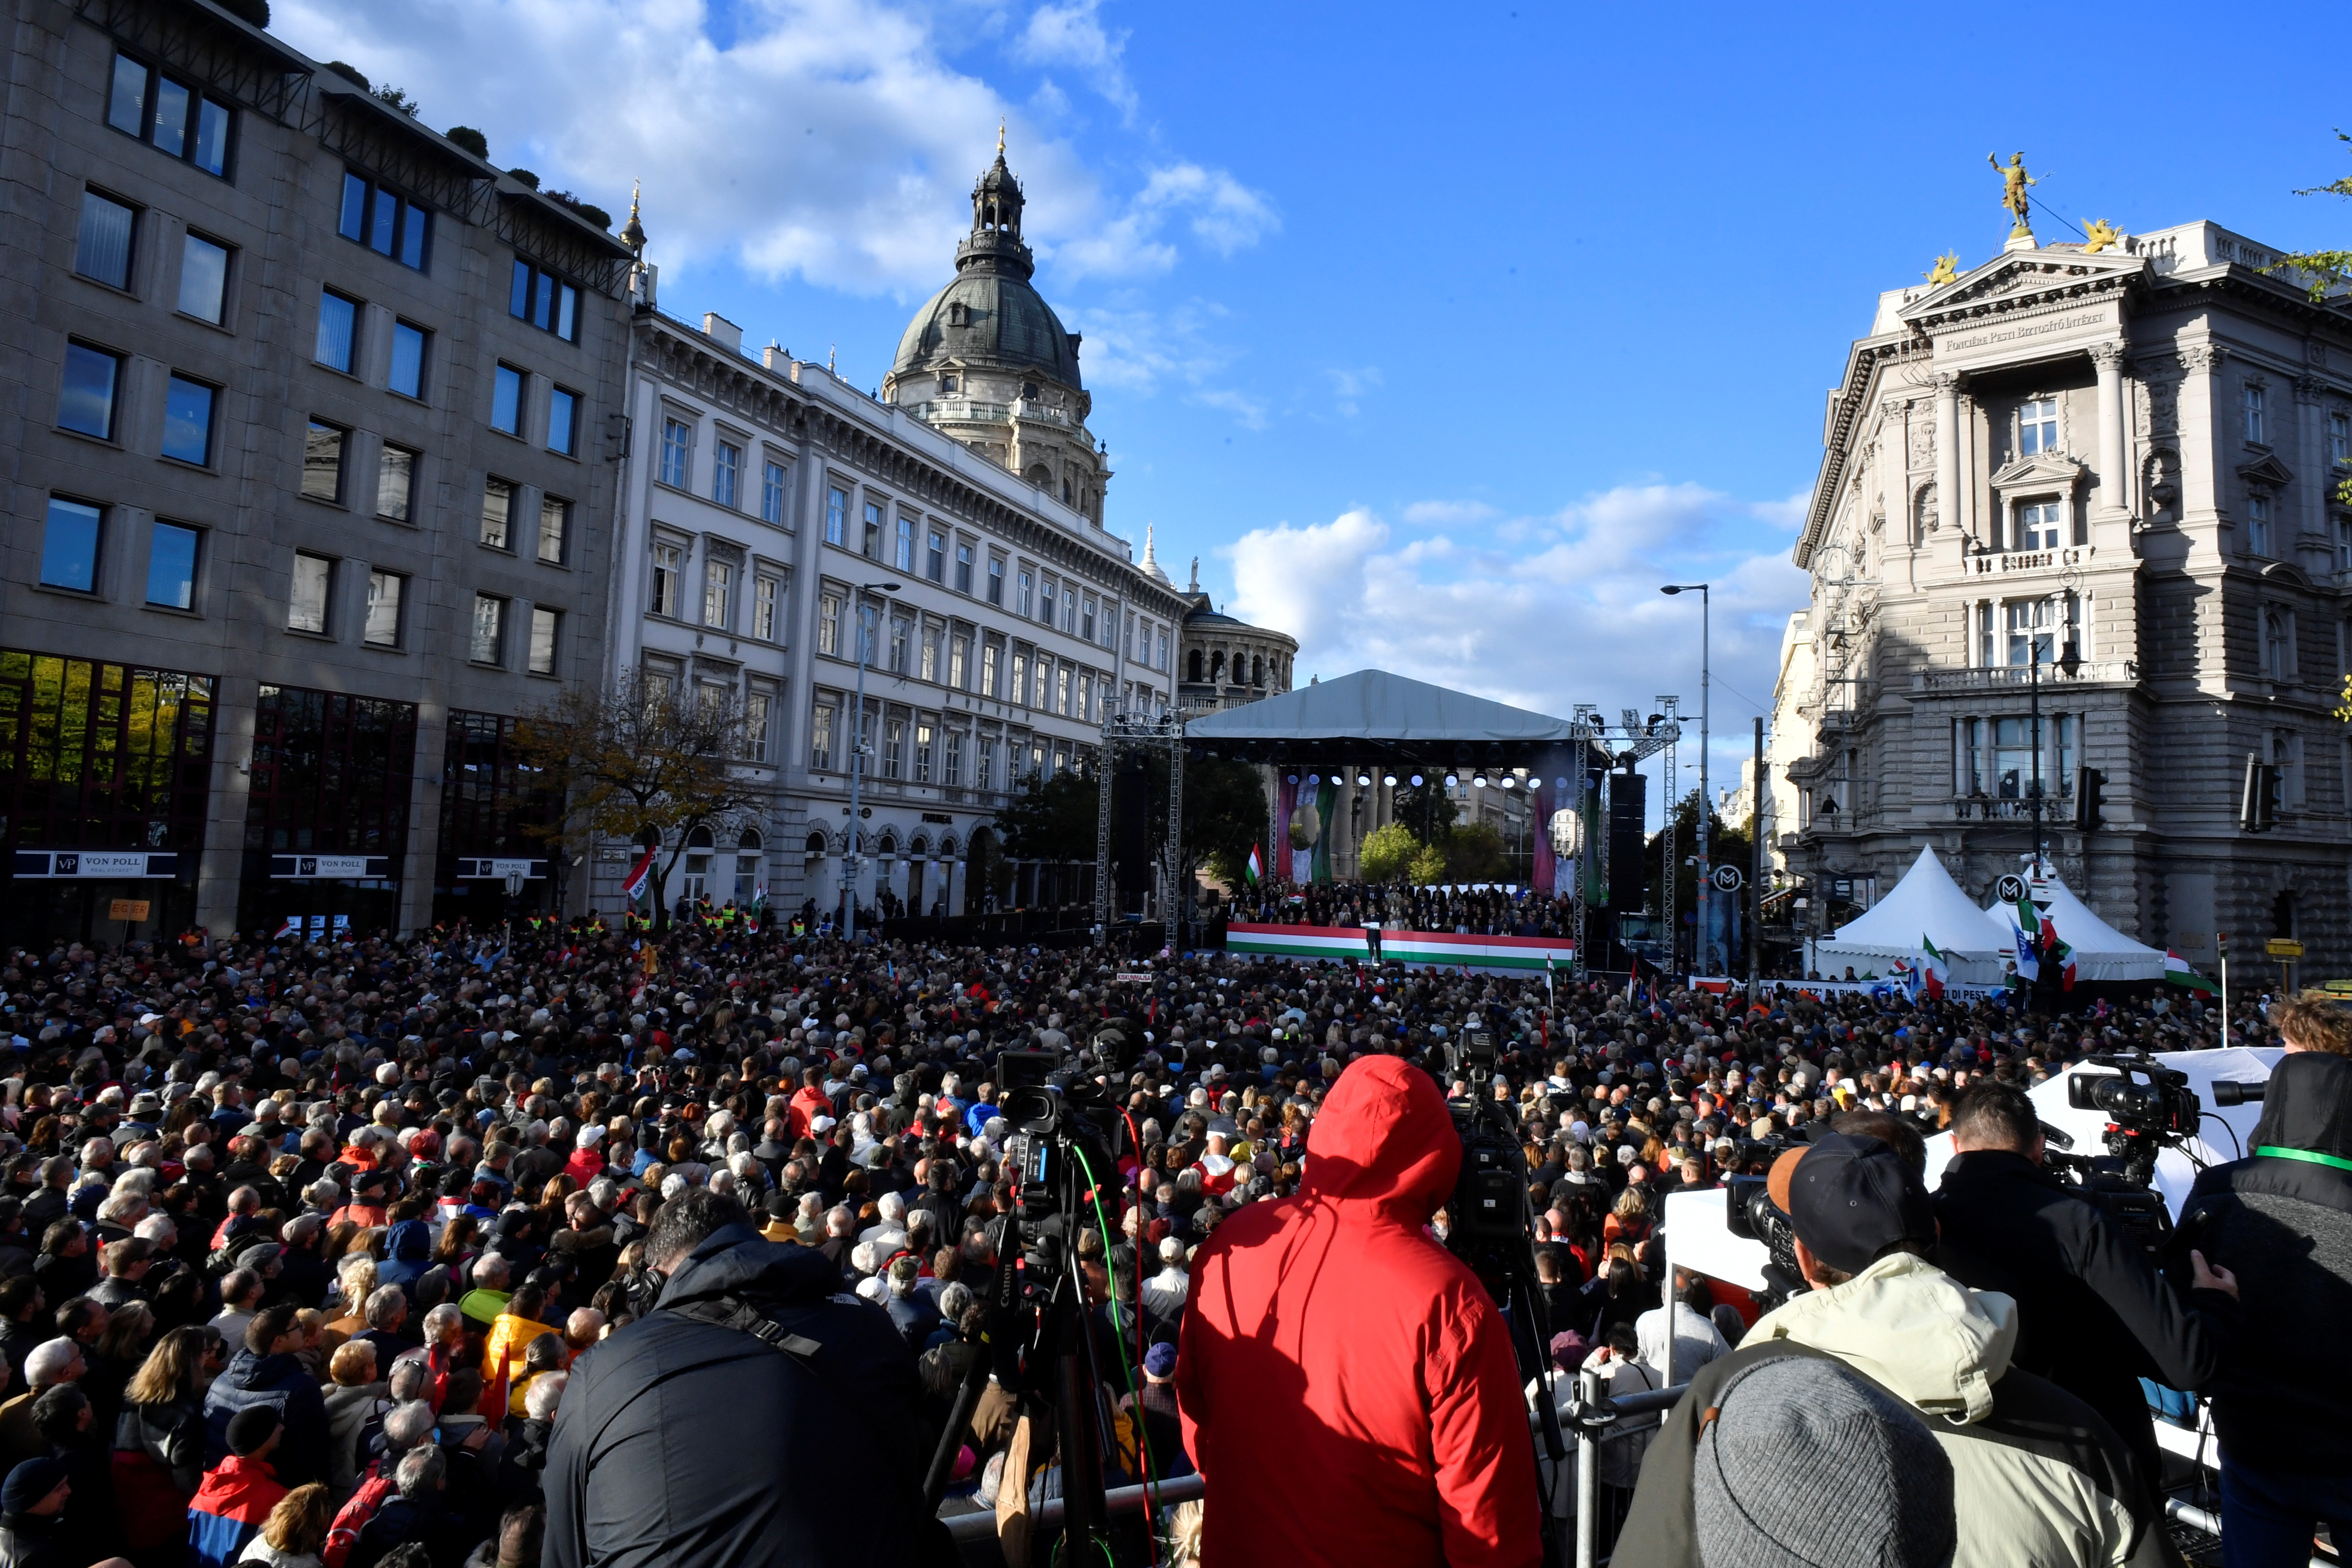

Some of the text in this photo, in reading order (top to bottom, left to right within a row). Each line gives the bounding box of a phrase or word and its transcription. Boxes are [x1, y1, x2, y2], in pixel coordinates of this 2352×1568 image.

[1991, 331, 2015, 343] PESTI
[2017, 320, 2064, 338] BIZTOSÍTÓ
[2066, 313, 2104, 329] INTÉZET
[59, 858, 76, 869] VP
[302, 861, 314, 871] VP
[112, 904, 147, 914] EGER
[1952, 989, 1960, 999] DI
[1964, 990, 1986, 1000] PEST
[1000, 1264, 1012, 1308] Canon
